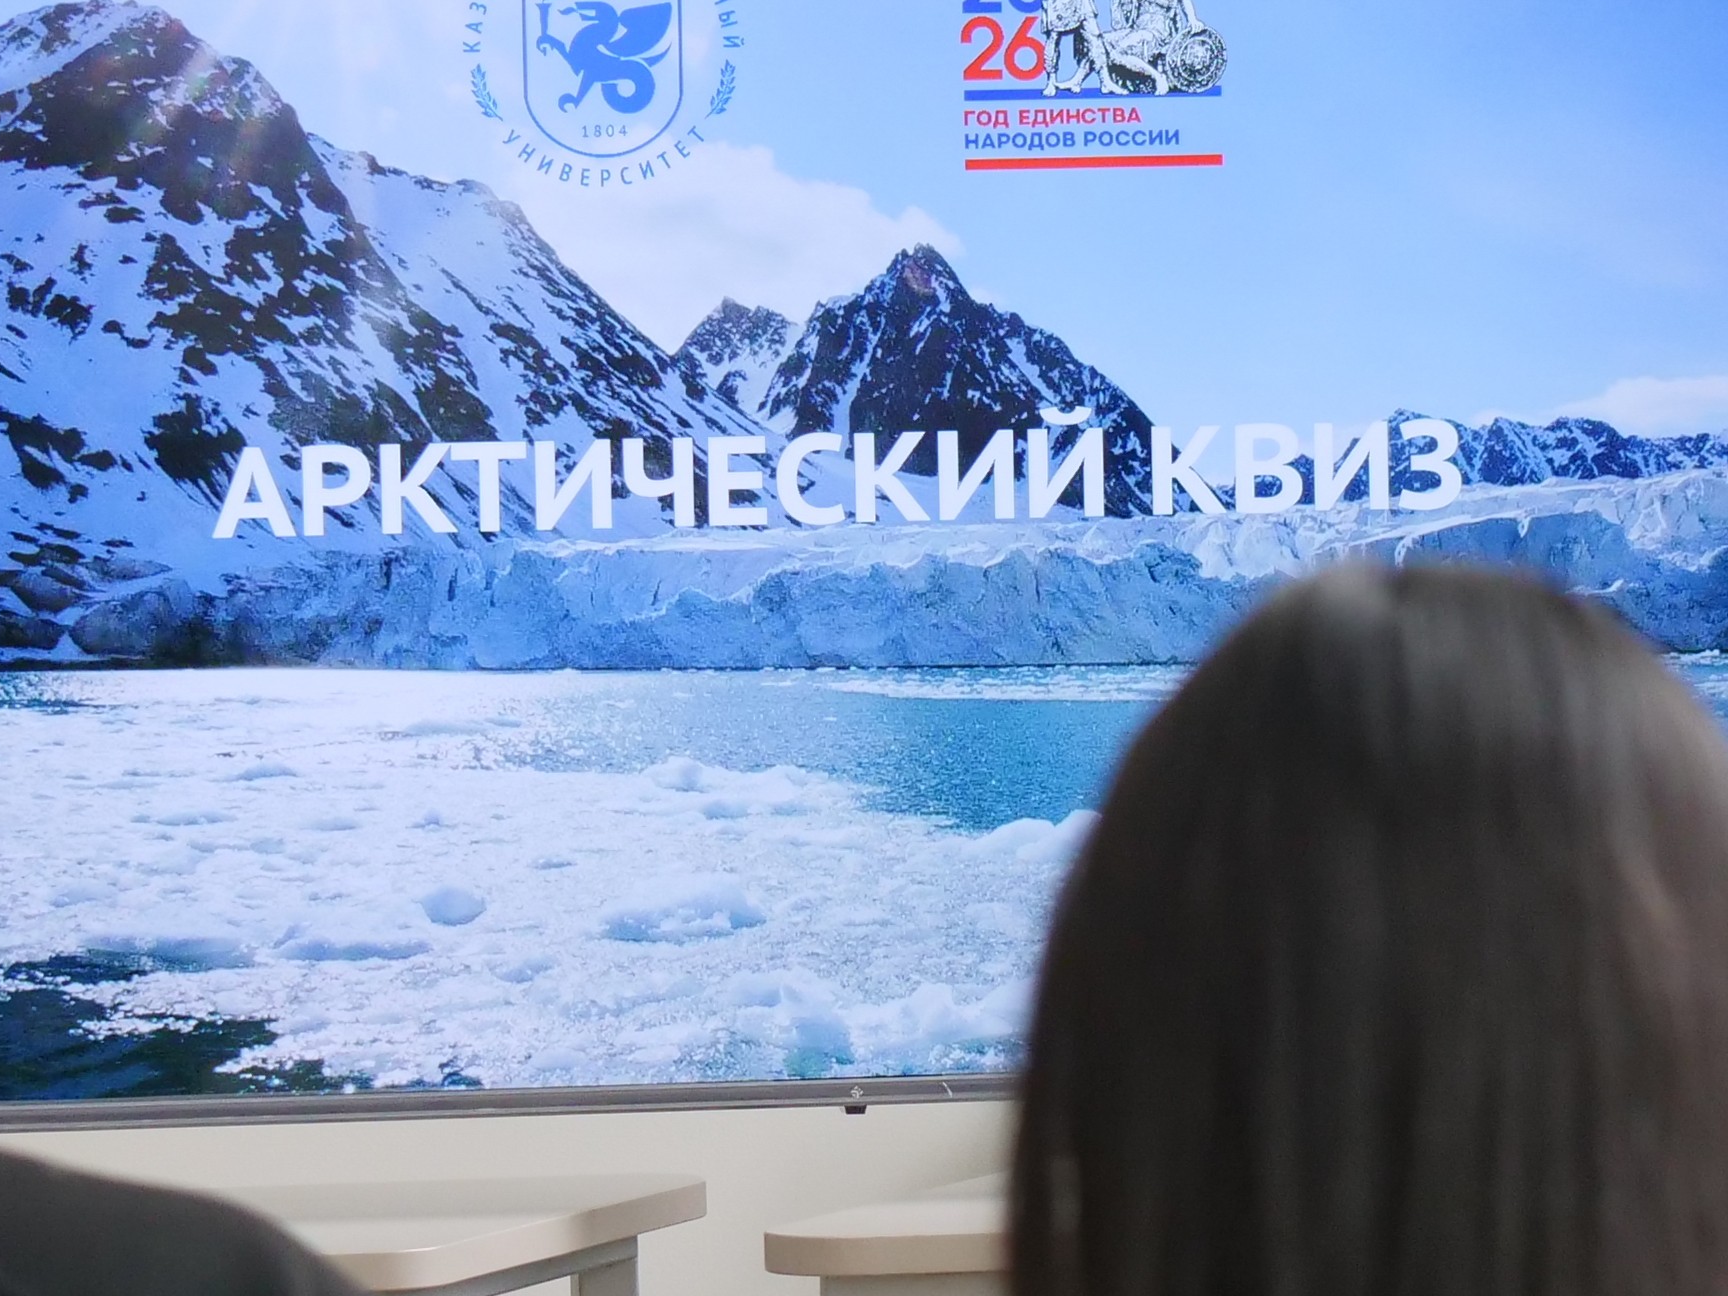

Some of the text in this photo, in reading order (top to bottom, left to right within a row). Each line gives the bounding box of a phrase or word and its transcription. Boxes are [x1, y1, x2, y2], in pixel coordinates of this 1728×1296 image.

[960, 15, 1046, 81] 26
[581, 124, 628, 138] 1804
[963, 107, 1142, 129] ГОД ЕДИНСТВА
[502, 125, 706, 187] УНИВЕРСИТЕТ
[964, 129, 1181, 151] НАРОДОВ РОССИИ
[212, 405, 1464, 539] АРКТИЧЕСКИЙ КВИЗ
